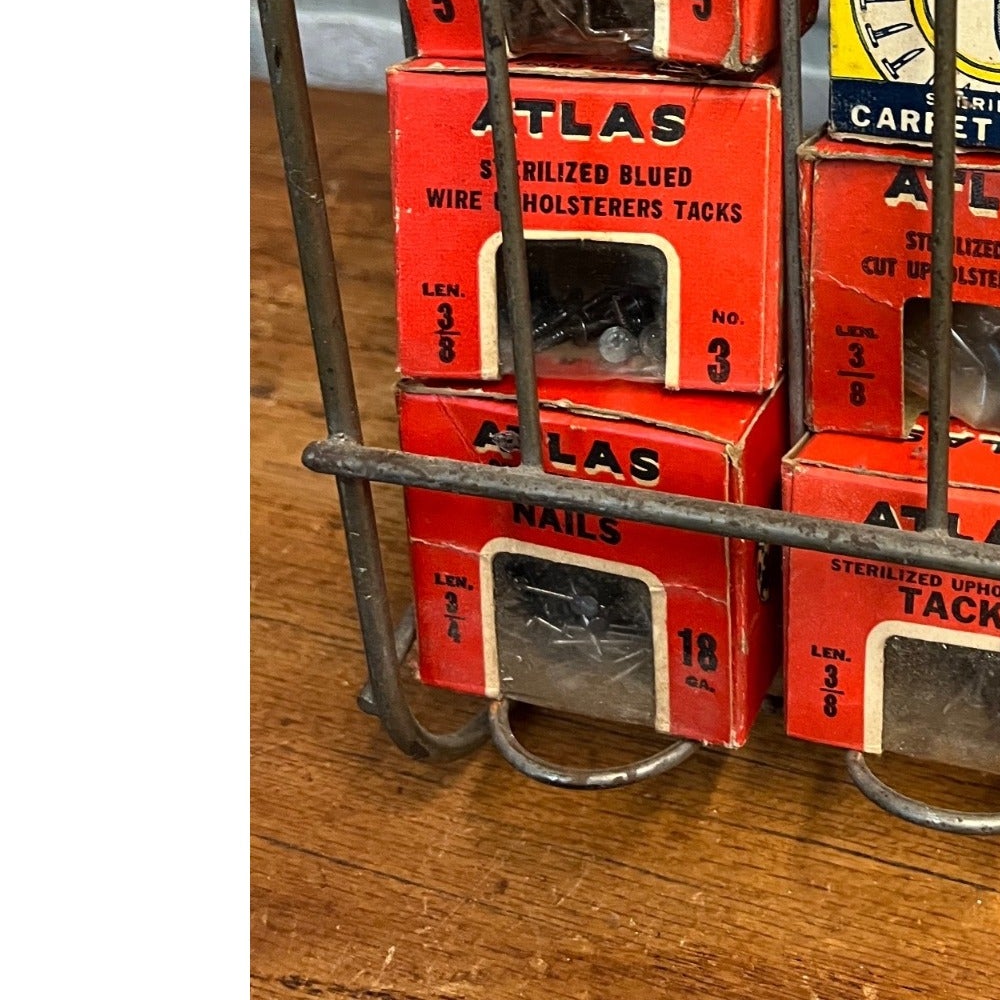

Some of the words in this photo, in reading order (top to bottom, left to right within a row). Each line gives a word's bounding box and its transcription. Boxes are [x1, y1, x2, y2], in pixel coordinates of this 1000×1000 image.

[480, 159, 610, 187] SRILIZED
[620, 165, 693, 188] BLUED
[426, 187, 483, 211] WIRE
[676, 199, 743, 224] TACKS
[861, 256, 898, 278] CUT
[422, 282, 466, 298] LEN.
[712, 309, 745, 325] NO.
[707, 337, 731, 385] 3
[473, 420, 660, 487] ALAS
[511, 502, 622, 546] NAILS
[831, 558, 943, 588] STERILIZED
[677, 628, 719, 671] 18
[811, 645, 851, 662] LEN.
